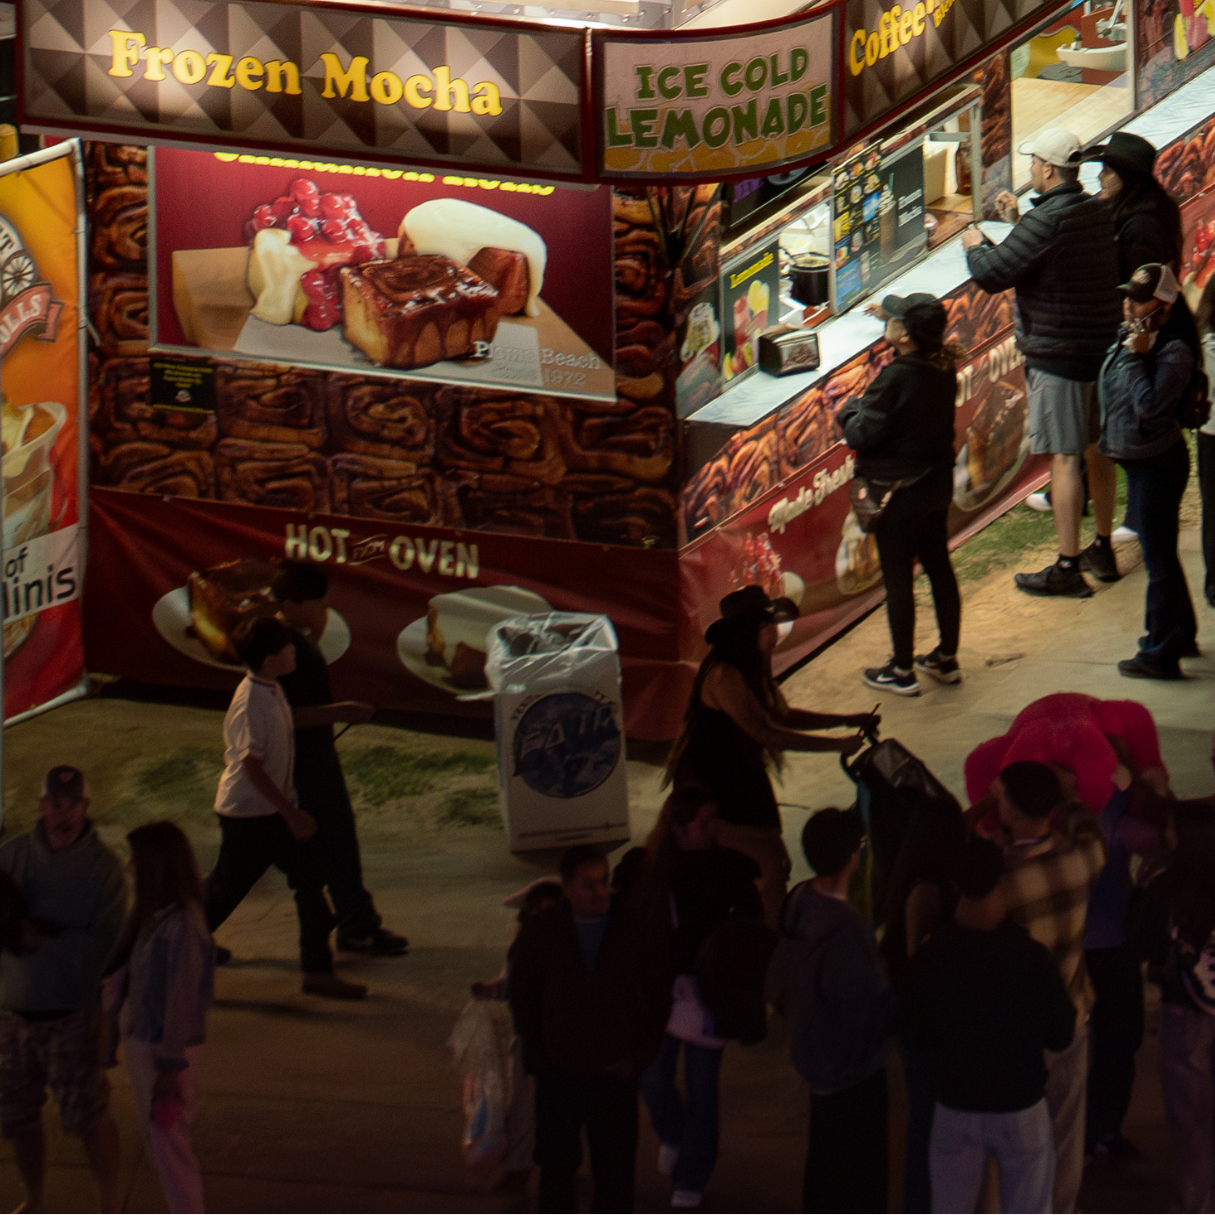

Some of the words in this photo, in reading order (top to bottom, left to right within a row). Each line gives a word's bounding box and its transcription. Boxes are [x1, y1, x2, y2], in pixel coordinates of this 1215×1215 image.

[849, 4, 927, 77] Coffee
[107, 29, 303, 96] Frozen
[319, 52, 504, 117] Mocha
[634, 63, 710, 101] ICE
[718, 45, 810, 98] COLD
[604, 82, 829, 150] LEMONADE
[540, 347, 601, 370] Beach
[5, 545, 29, 578] of
[284, 522, 351, 564] HOT
[388, 535, 480, 580] OVEN
